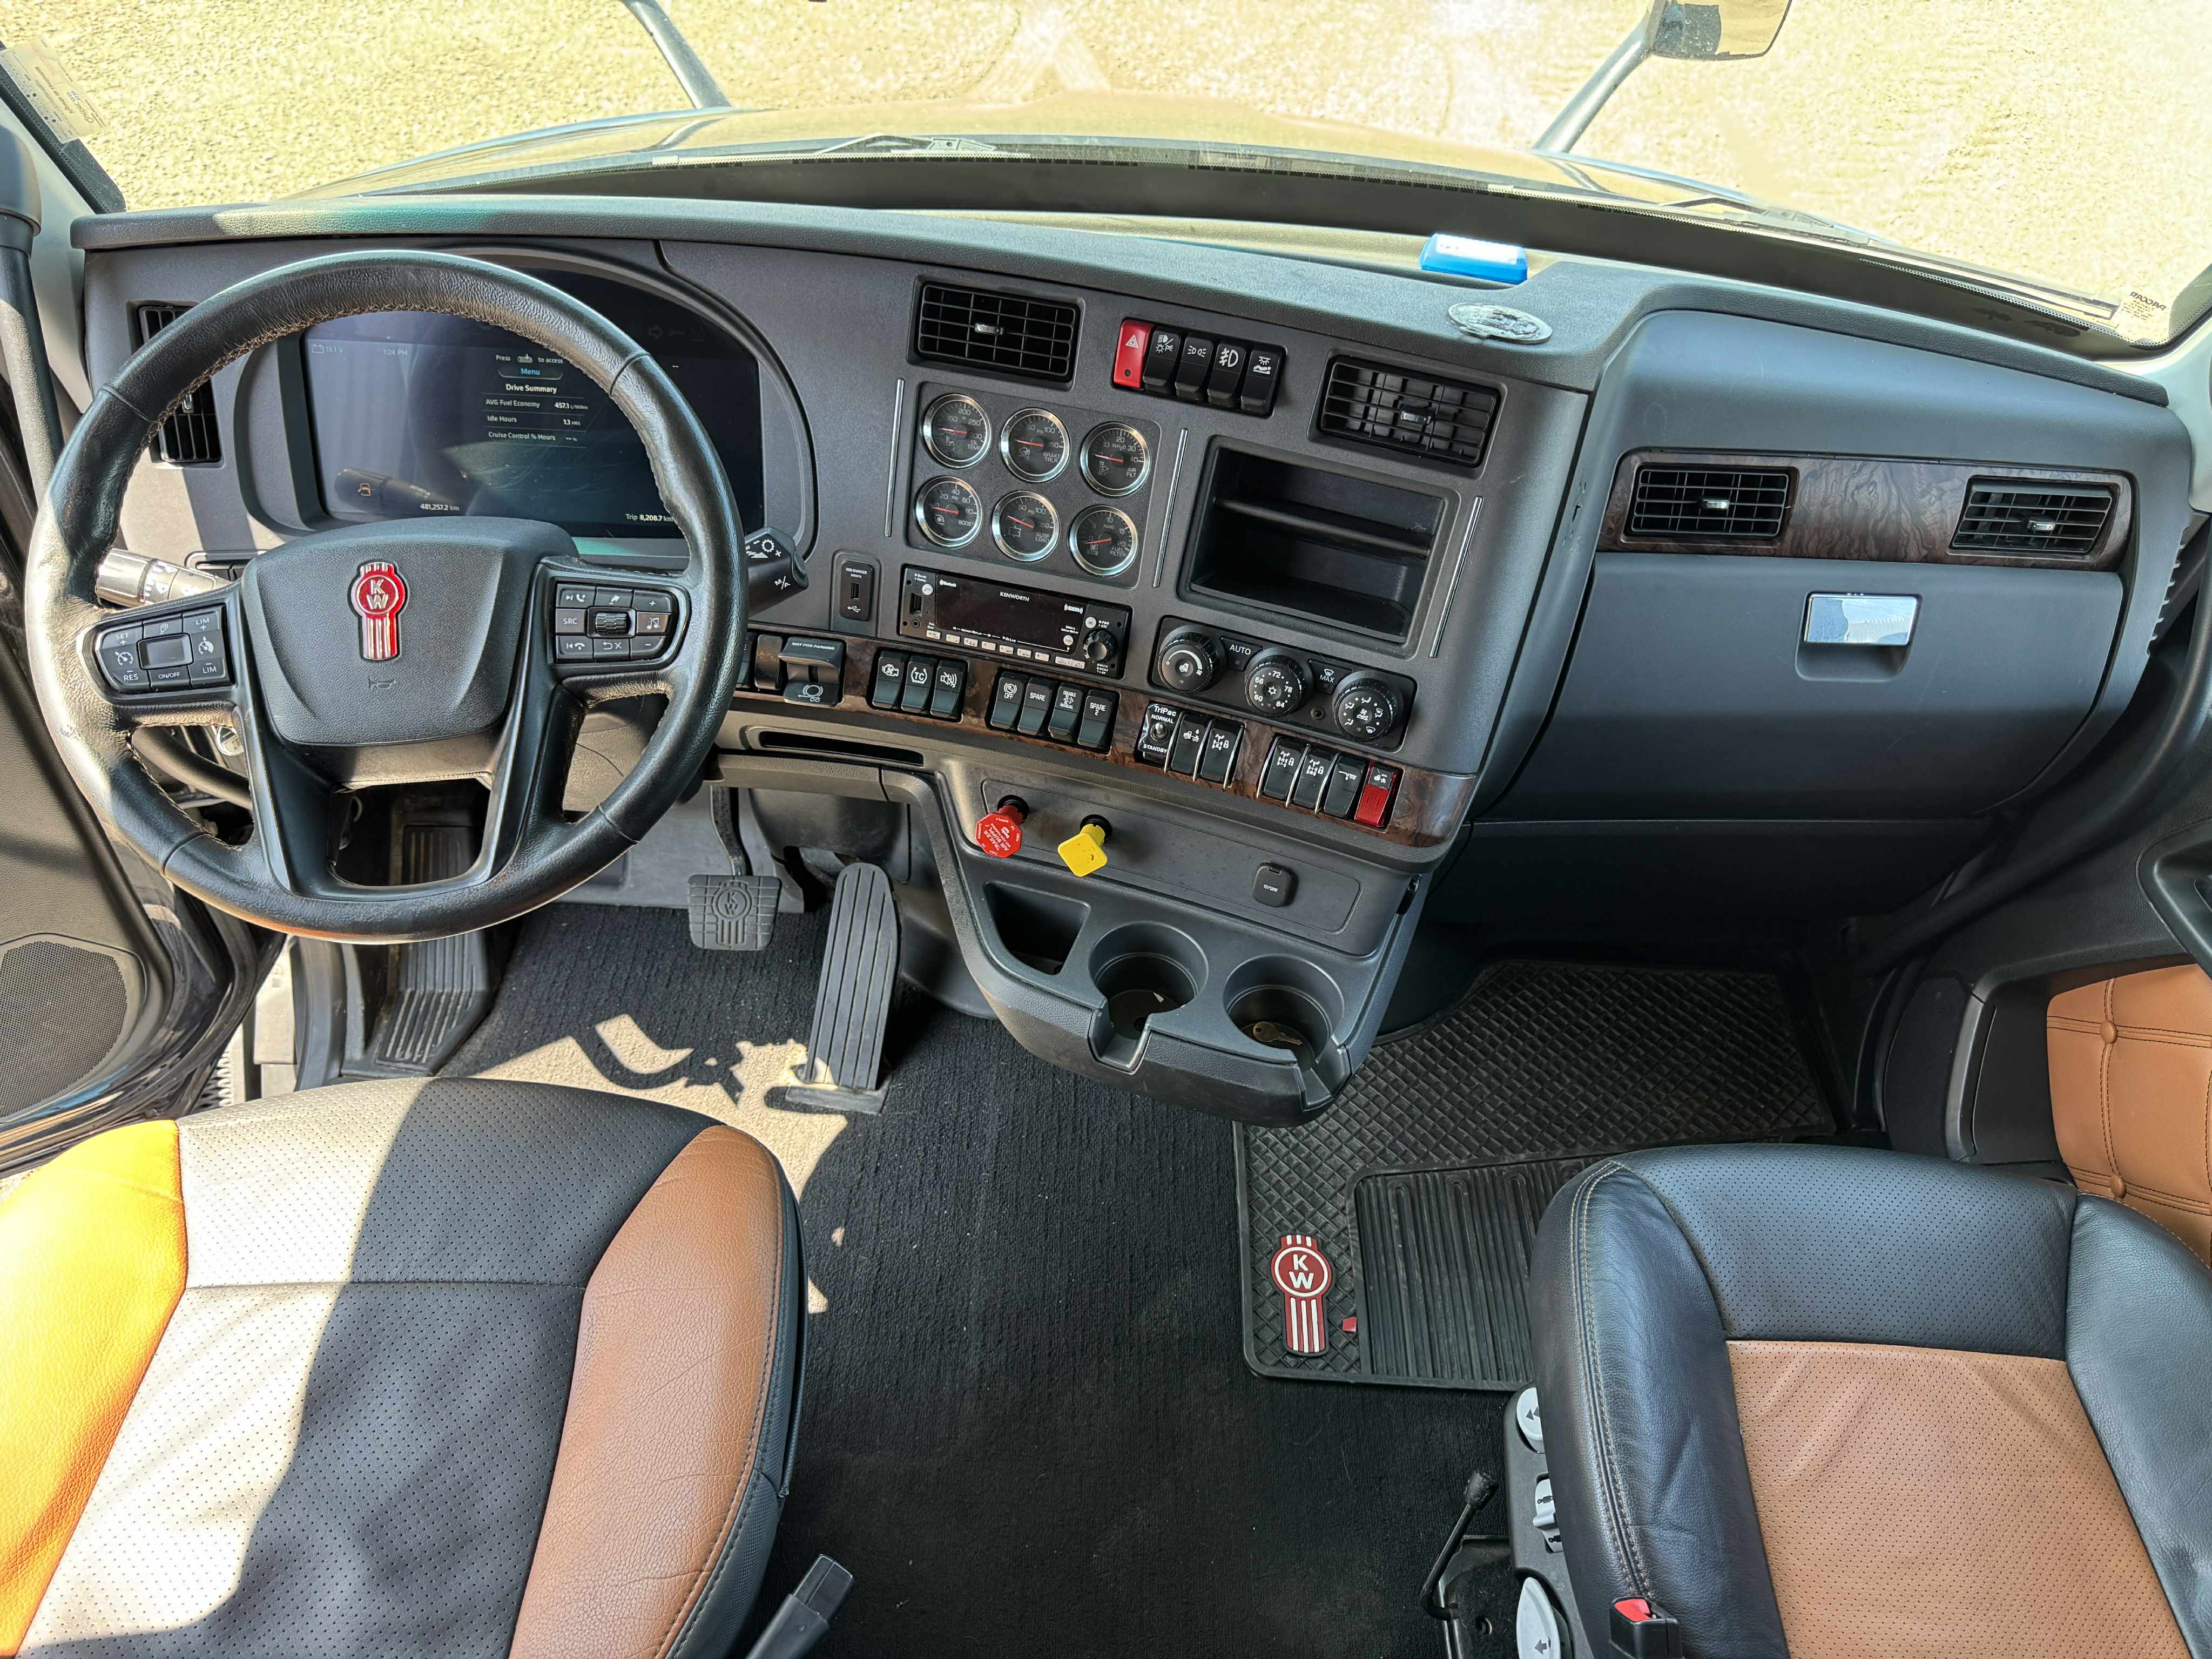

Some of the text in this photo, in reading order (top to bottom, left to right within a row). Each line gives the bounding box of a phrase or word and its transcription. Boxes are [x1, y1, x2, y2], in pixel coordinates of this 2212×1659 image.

[520, 368, 541, 376] Menu
[505, 383, 557, 394] Drive Summary
[514, 400, 540, 408] Economy
[1043, 451, 1062, 460] BRAKE
[1000, 591, 1030, 602] KENWORTH
[195, 617, 210, 625] LIM
[115, 632, 130, 640] SET
[1229, 644, 1251, 655] AUTO
[203, 665, 217, 674] LIM
[1272, 670, 1282, 678] 72
[123, 673, 139, 682] RES
[158, 671, 180, 679] ON/OFF
[914, 671, 925, 681] TC
[1319, 674, 1335, 684] MAX
[1255, 676, 1264, 685] 66
[1284, 685, 1293, 693] 78
[1029, 692, 1046, 702] SPARE
[1253, 694, 1263, 702] 60
[1089, 702, 1107, 712] SPARE
[1154, 705, 1177, 717] TriPac
[1151, 713, 1175, 724] NORMAL
[1143, 743, 1168, 754] STANDBY
[983, 830, 1002, 851] TRAILER
[984, 824, 1010, 851] AIR SUPPLY
[1292, 1253, 1309, 1271] K
[1289, 1271, 1314, 1289] W
